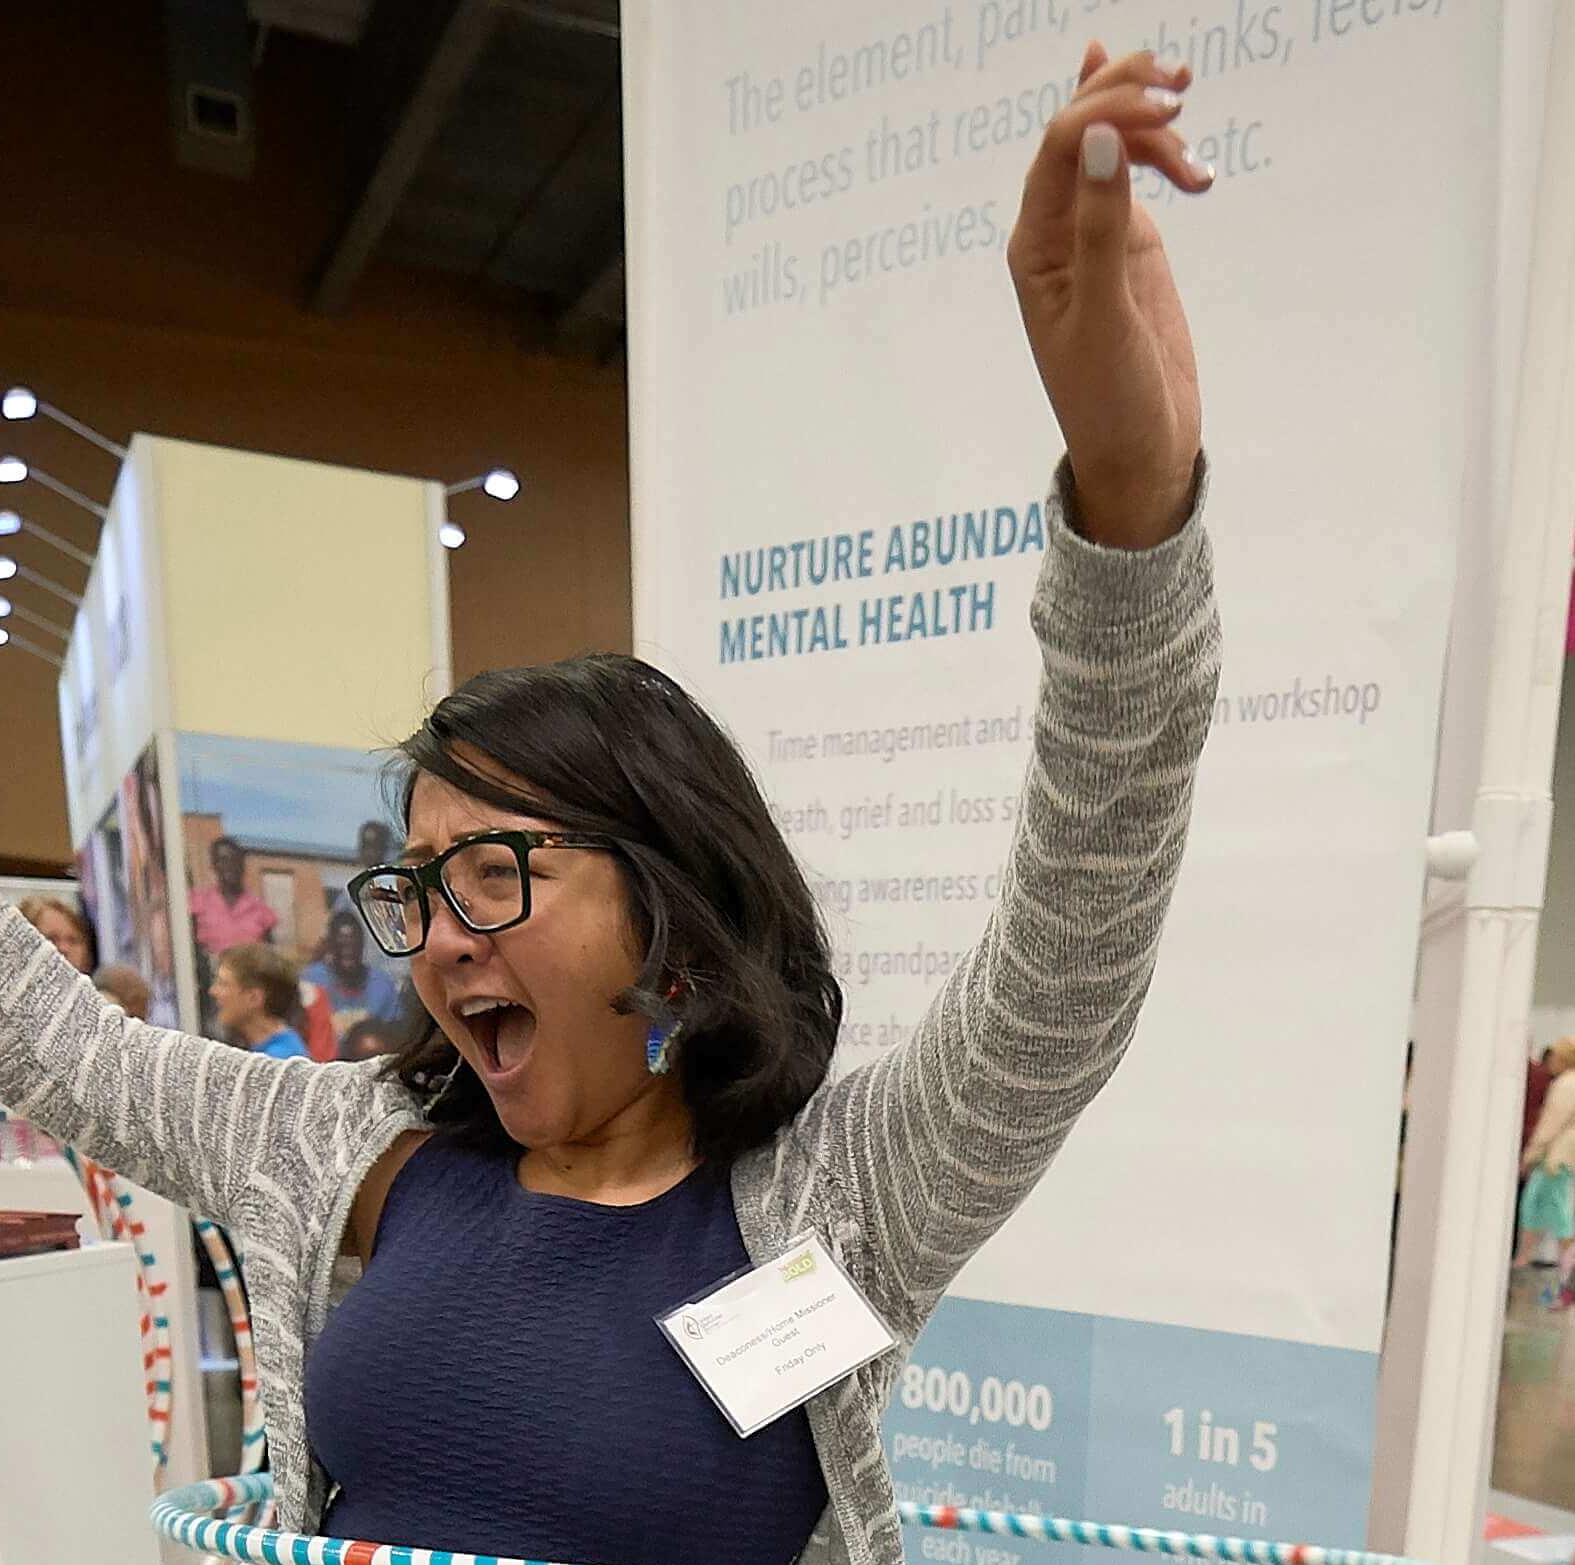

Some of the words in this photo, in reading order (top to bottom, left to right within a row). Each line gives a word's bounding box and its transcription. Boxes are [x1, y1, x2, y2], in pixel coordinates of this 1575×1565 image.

[723, 70, 785, 136] The
[793, 7, 965, 112] element,
[723, 146, 855, 246] process
[864, 112, 940, 184] that
[952, 76, 1078, 158] reaso
[722, 240, 807, 315] wills,
[819, 199, 1009, 305] perceives,
[720, 529, 874, 600] NURTURE
[883, 501, 1045, 575] ABUNDA
[720, 602, 848, 664] MENTAL
[859, 580, 995, 646] HEALTH
[768, 729, 817, 763] Time
[823, 714, 970, 763] management
[976, 704, 1022, 744] and
[1237, 674, 1381, 726] workshop
[840, 792, 894, 840] grief
[899, 790, 942, 827] and
[950, 788, 996, 825] loss
[859, 876, 978, 904] awareness
[774, 1355, 804, 1375] Friday
[804, 1342, 826, 1358] Only
[901, 1364, 1053, 1431] 800,000
[894, 1432, 965, 1470] people
[969, 1438, 1002, 1474] die
[1005, 1441, 1057, 1483] from
[1161, 1407, 1184, 1456] 1
[1198, 1408, 1239, 1467] in
[1249, 1420, 1279, 1472] 5
[1161, 1476, 1240, 1523] adults
[1242, 1491, 1267, 1526] in
[921, 1534, 971, 1565] each
